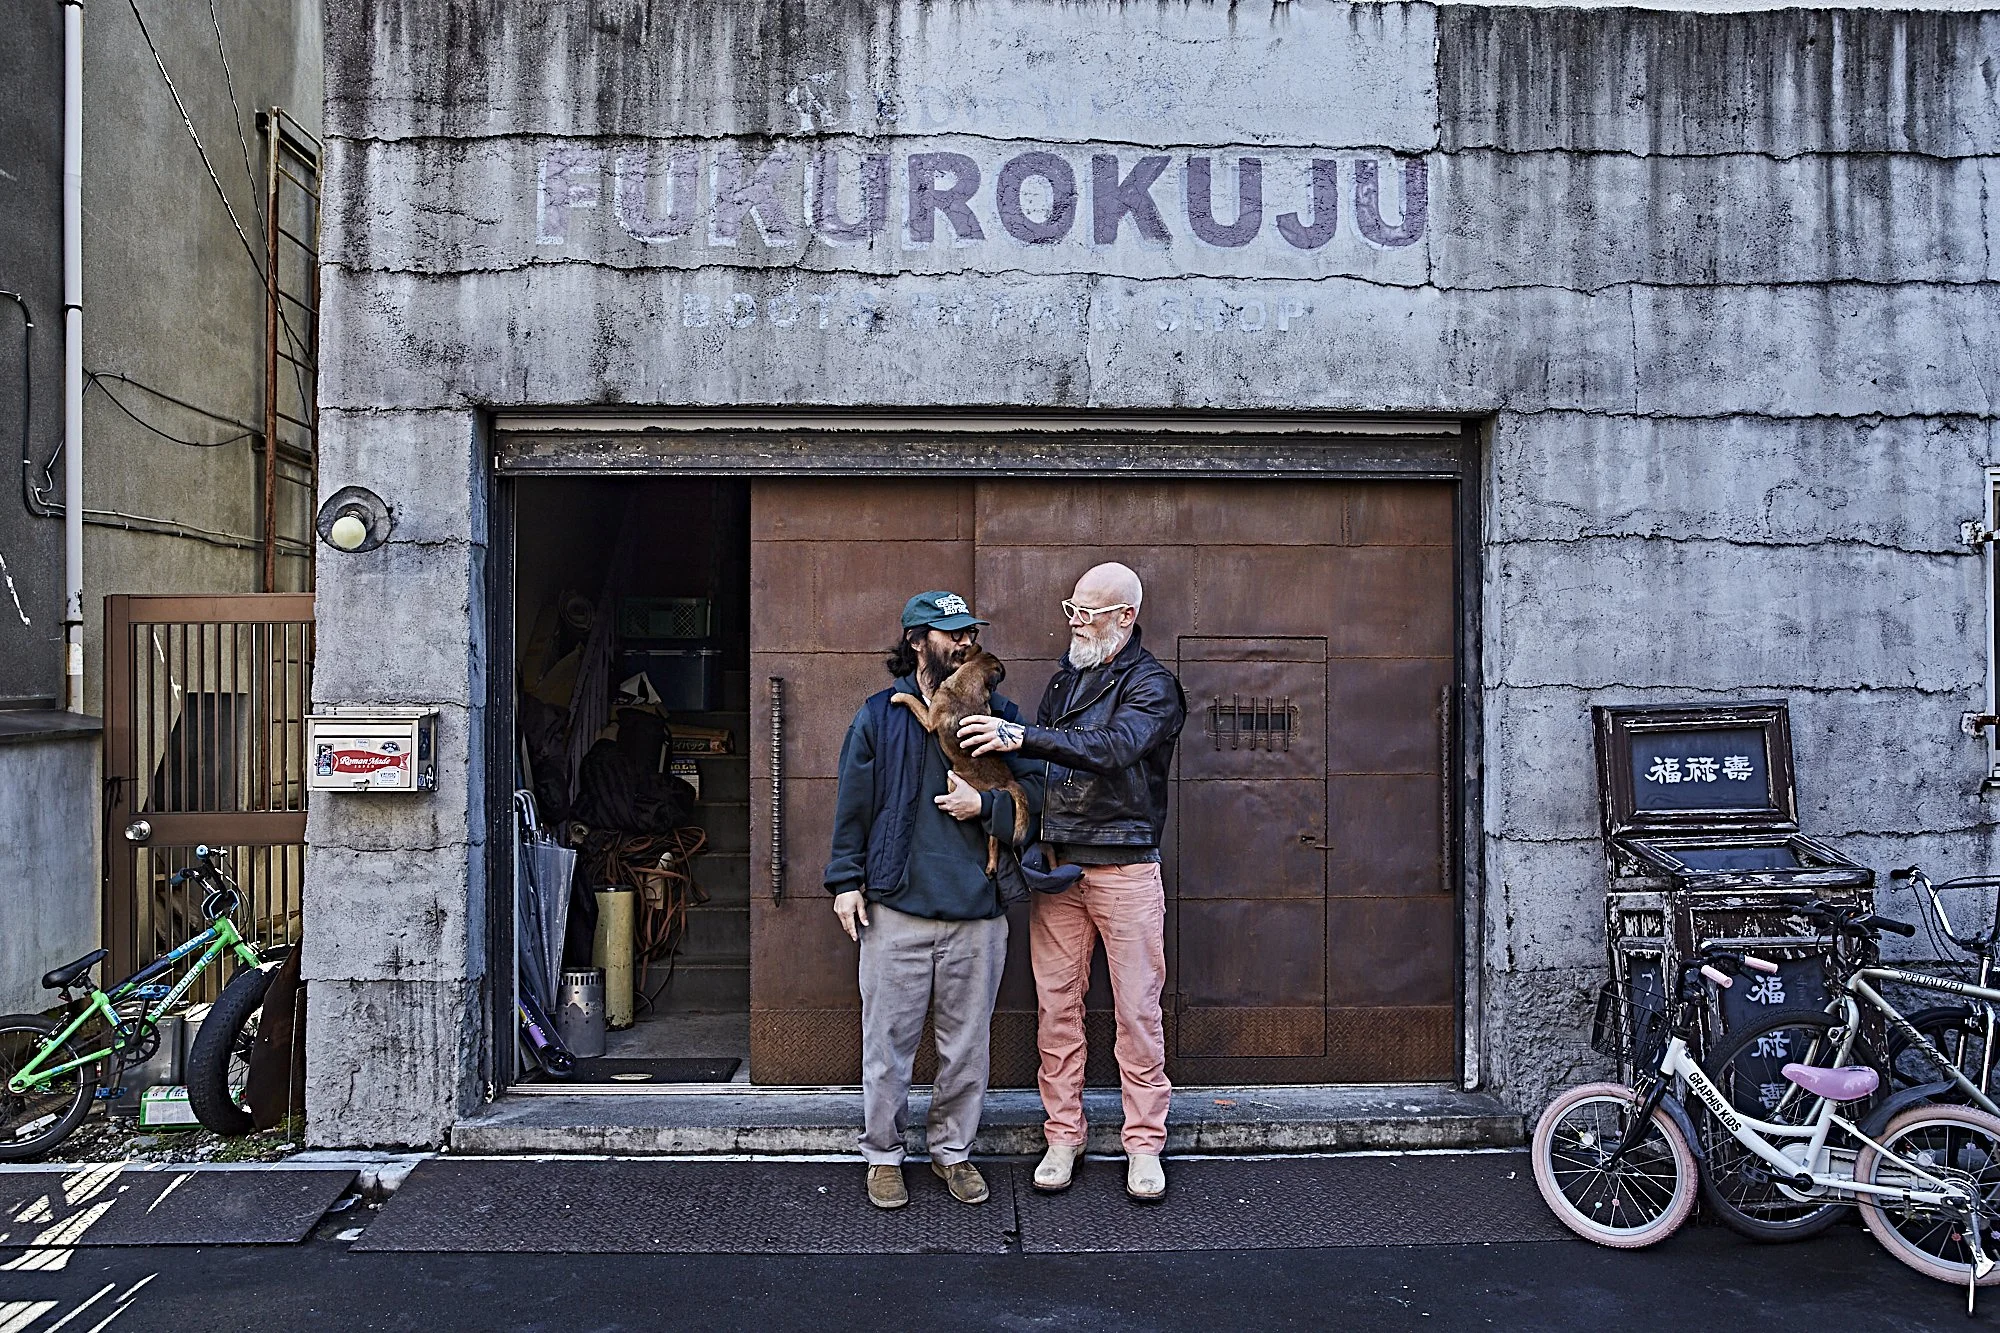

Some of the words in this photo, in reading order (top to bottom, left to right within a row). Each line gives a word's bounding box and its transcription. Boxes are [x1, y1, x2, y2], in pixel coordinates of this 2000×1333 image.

[536, 149, 1428, 250] FUKUROKUJU
[340, 756, 368, 766] Roman
[368, 757, 391, 766] Made
[152, 966, 200, 1018] SHREDDER
[1899, 971, 1964, 992] SPECIALIZED
[1688, 1072, 1724, 1112] GRAPHIS
